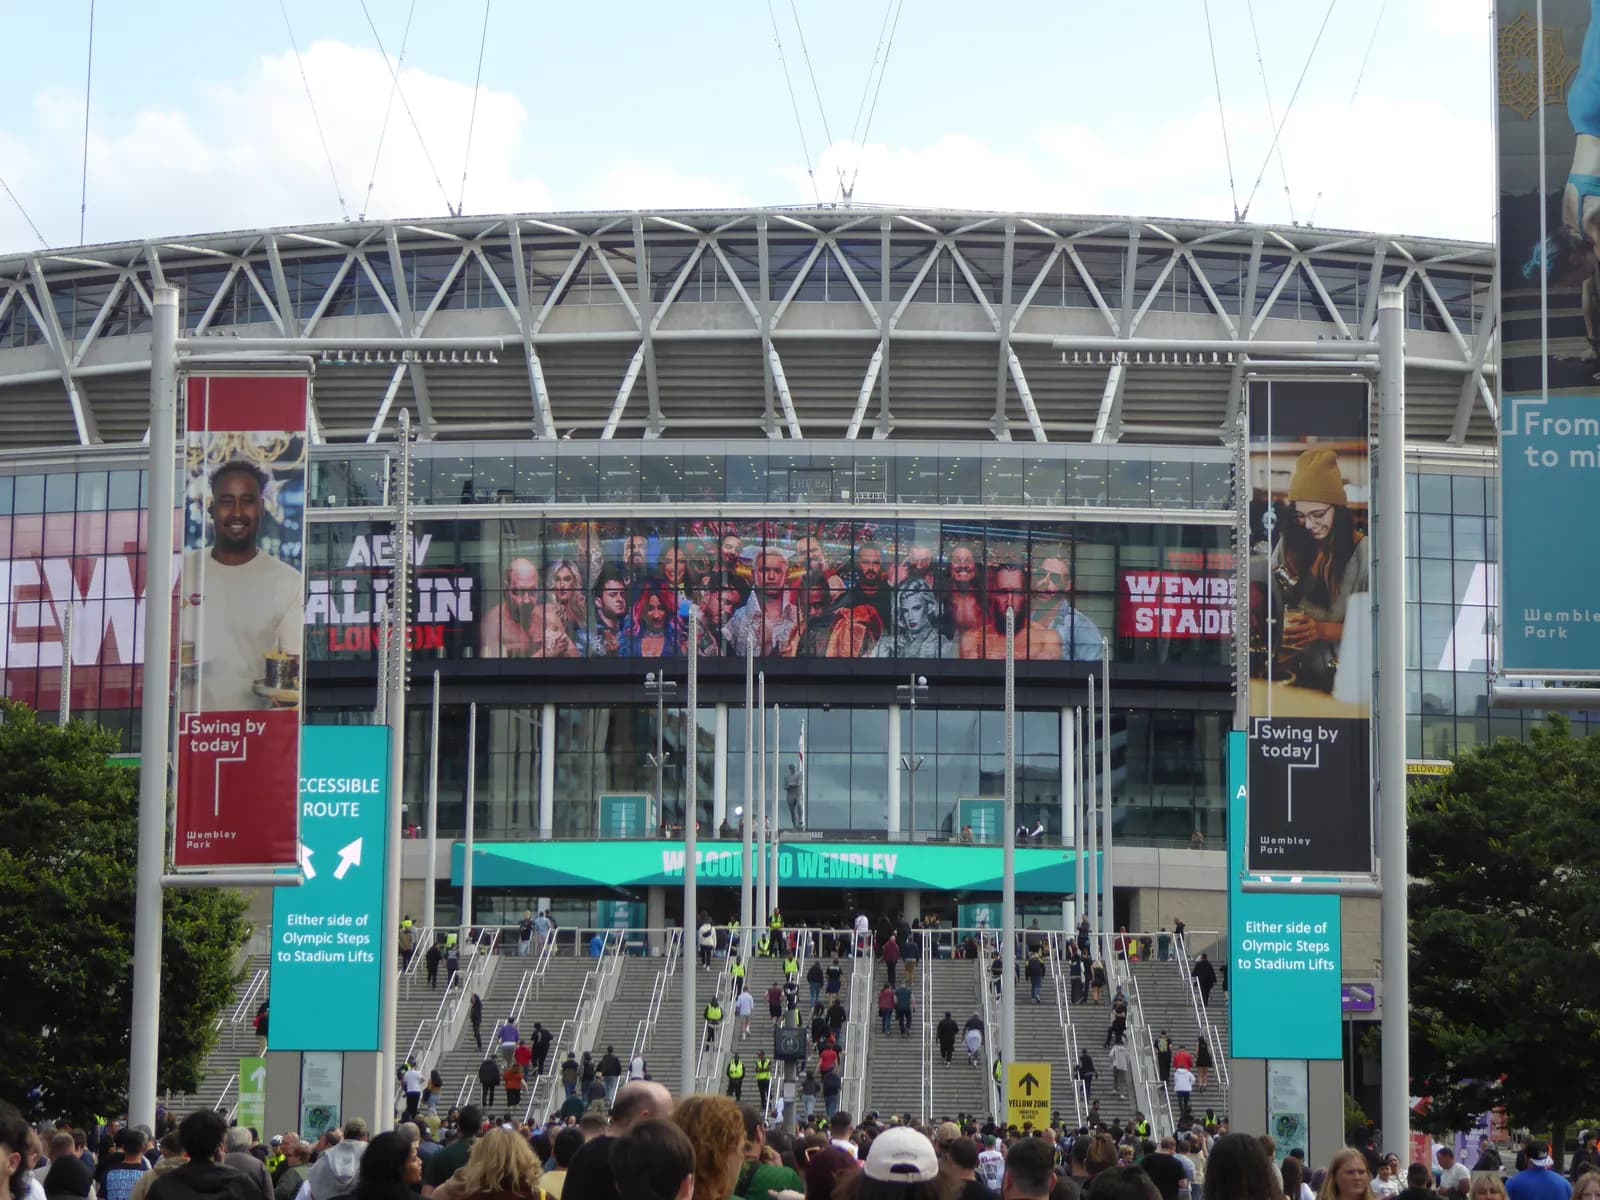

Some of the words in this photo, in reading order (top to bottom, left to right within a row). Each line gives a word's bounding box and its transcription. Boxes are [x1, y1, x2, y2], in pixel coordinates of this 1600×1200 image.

[1525, 411, 1599, 436] From
[1524, 446, 1558, 467] to
[346, 534, 432, 566] AEW
[417, 577, 473, 622] IN
[329, 625, 445, 652] LONON
[1524, 625, 1568, 639] Park
[191, 719, 241, 735] Swing
[245, 719, 266, 735] by
[1261, 725, 1312, 742] Swing
[1318, 725, 1338, 743] by
[190, 738, 240, 754] today
[1261, 743, 1312, 760] today
[303, 802, 360, 817] ROUTE
[186, 831, 236, 840] Wembley
[1260, 836, 1311, 846] Wembley
[186, 841, 211, 849] Park
[1260, 845, 1285, 854] Park
[797, 852, 898, 880] WEMBLEY
[287, 913, 324, 926] Either
[327, 914, 352, 926] side
[355, 914, 369, 926] of
[1246, 921, 1282, 933] Either
[1286, 922, 1311, 934] side
[1314, 922, 1328, 934] of
[283, 932, 333, 947] Olympic
[337, 933, 370, 947] Steps
[1242, 939, 1293, 954] Olympic
[1296, 940, 1330, 955] Steps
[278, 951, 291, 962] to
[294, 950, 345, 962] Stadium
[348, 951, 374, 963] Lifts
[1238, 959, 1251, 969] to
[1254, 958, 1305, 970] Stadium
[1308, 959, 1335, 970] Lifts
[1008, 1099, 1033, 1108] YELLOW
[1033, 1099, 1048, 1108] ZONE
